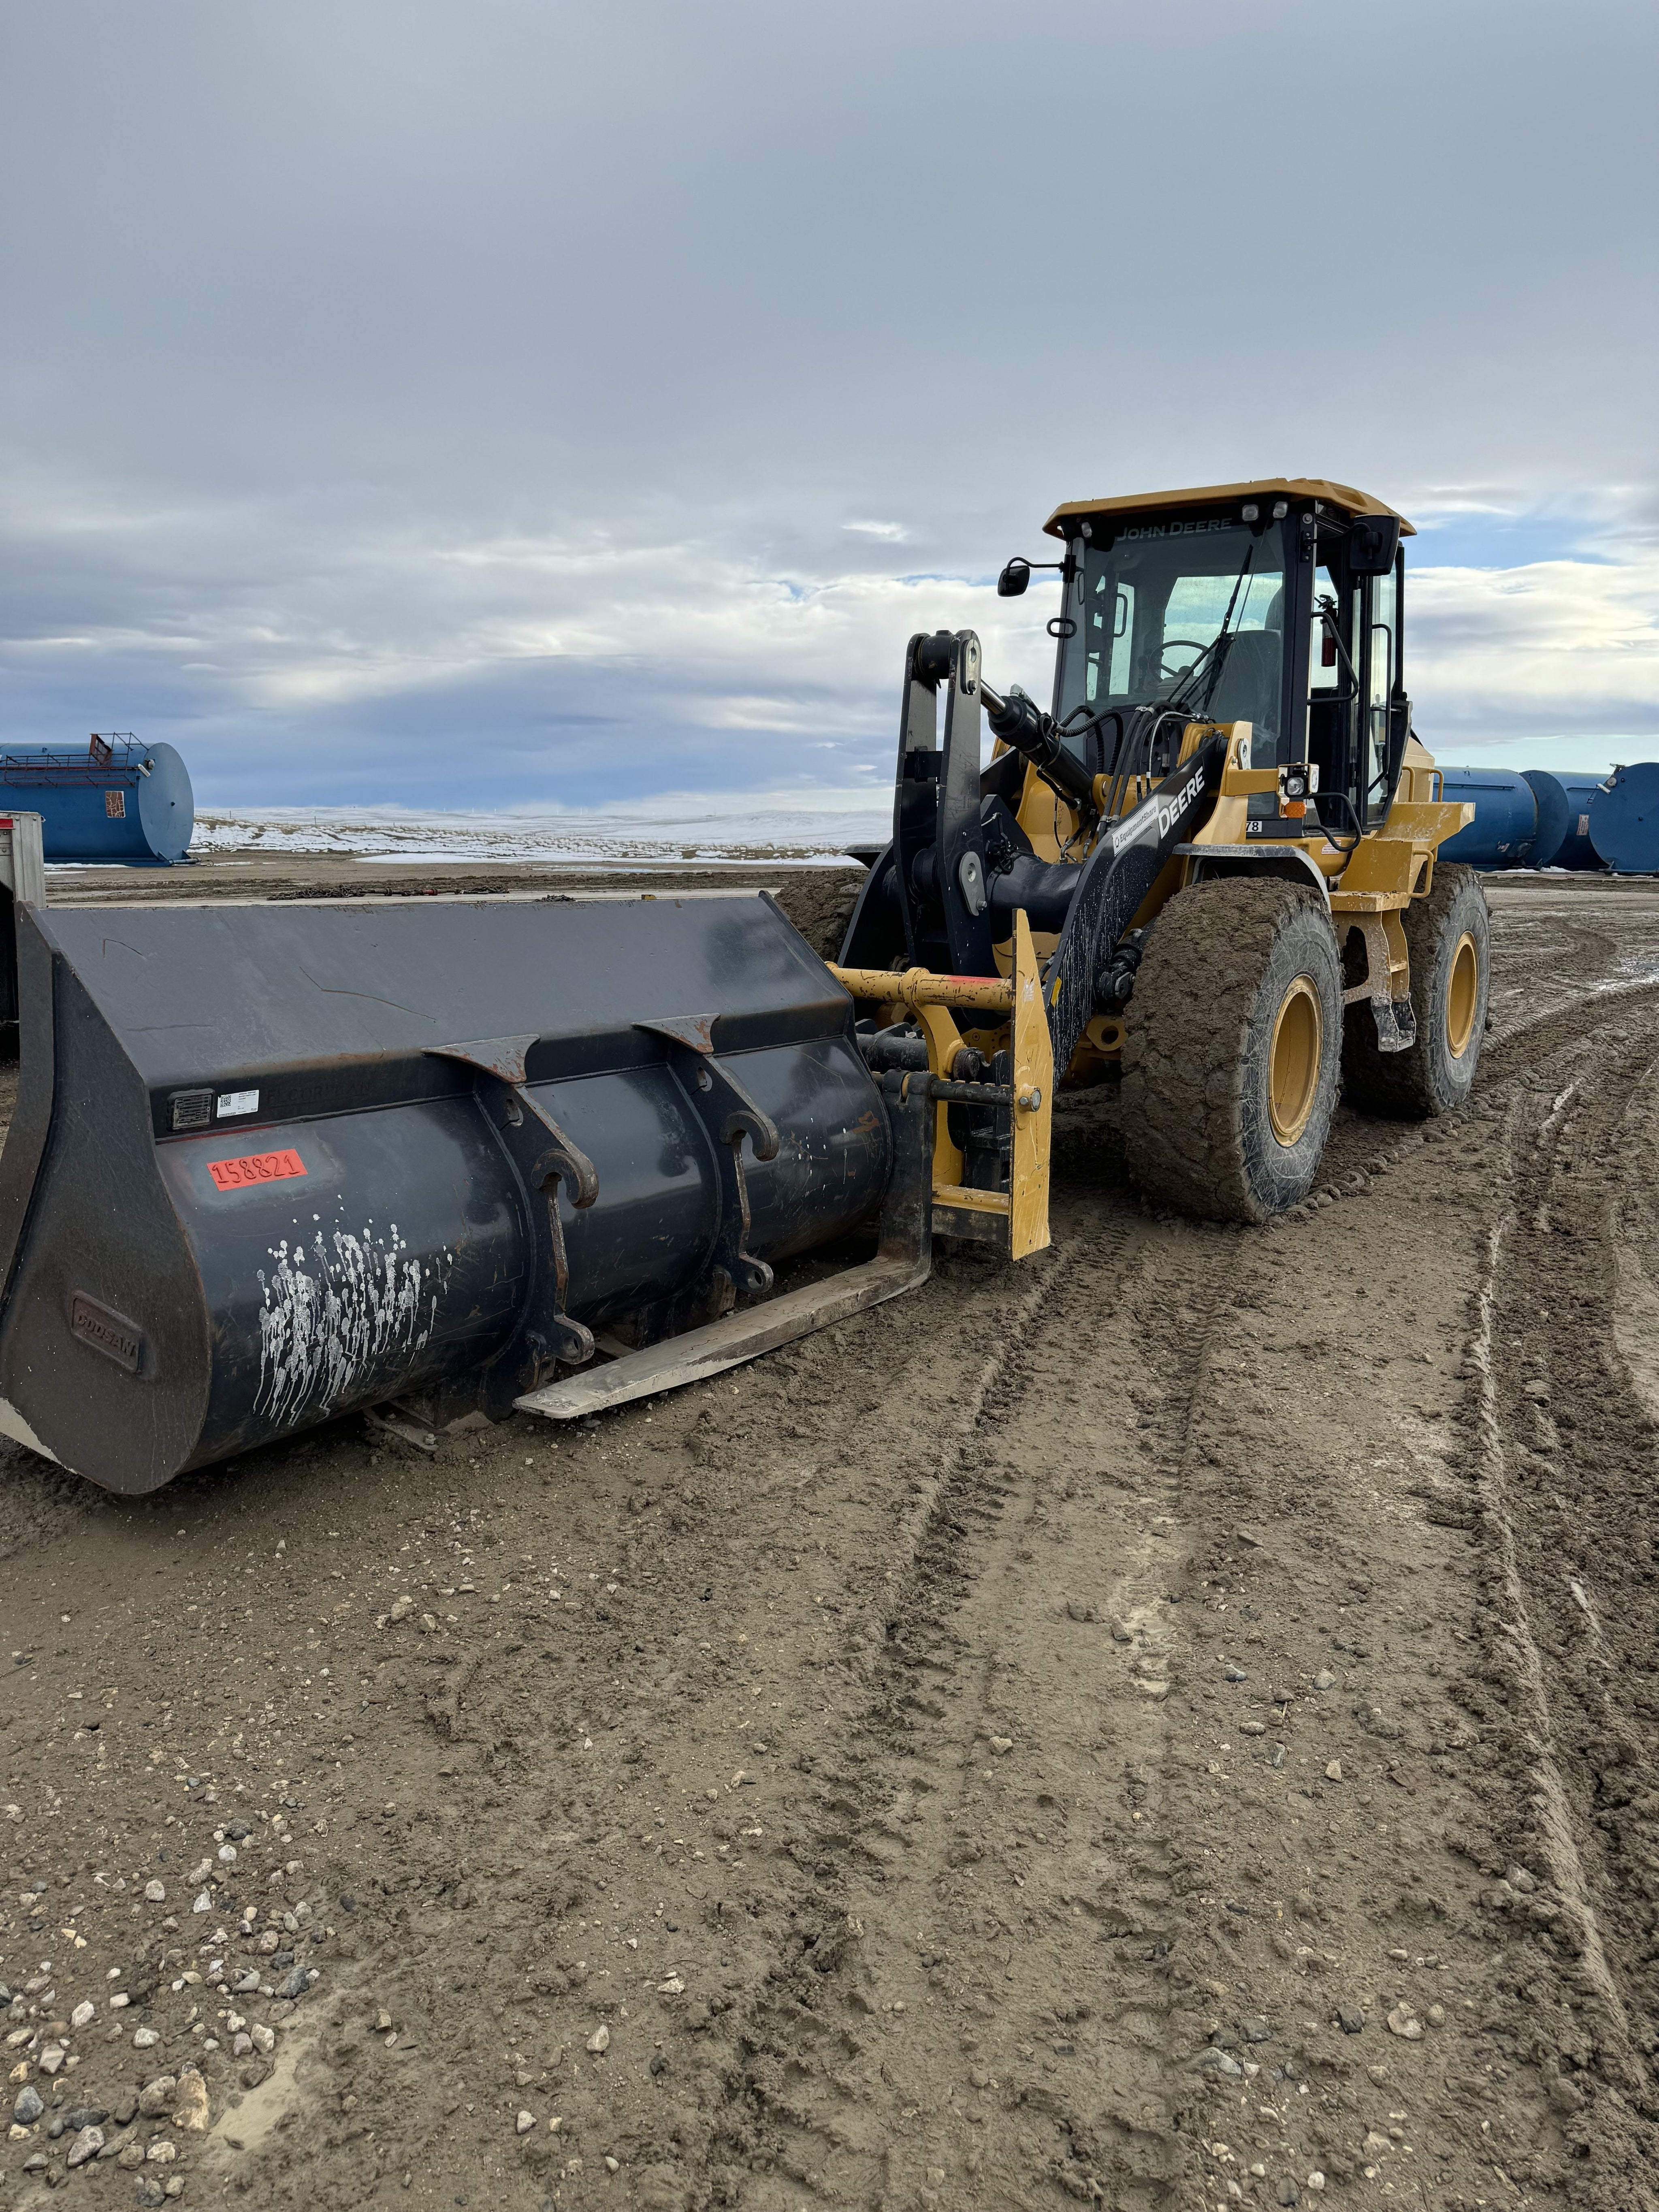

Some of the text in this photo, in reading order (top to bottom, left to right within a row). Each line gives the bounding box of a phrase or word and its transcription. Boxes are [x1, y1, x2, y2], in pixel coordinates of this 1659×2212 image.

[1117, 518, 1232, 541] JOHN DEERE
[1158, 766, 1205, 840] DEERE
[1120, 806, 1156, 843] EquipmentShare
[212, 1154, 300, 1184] 158821
